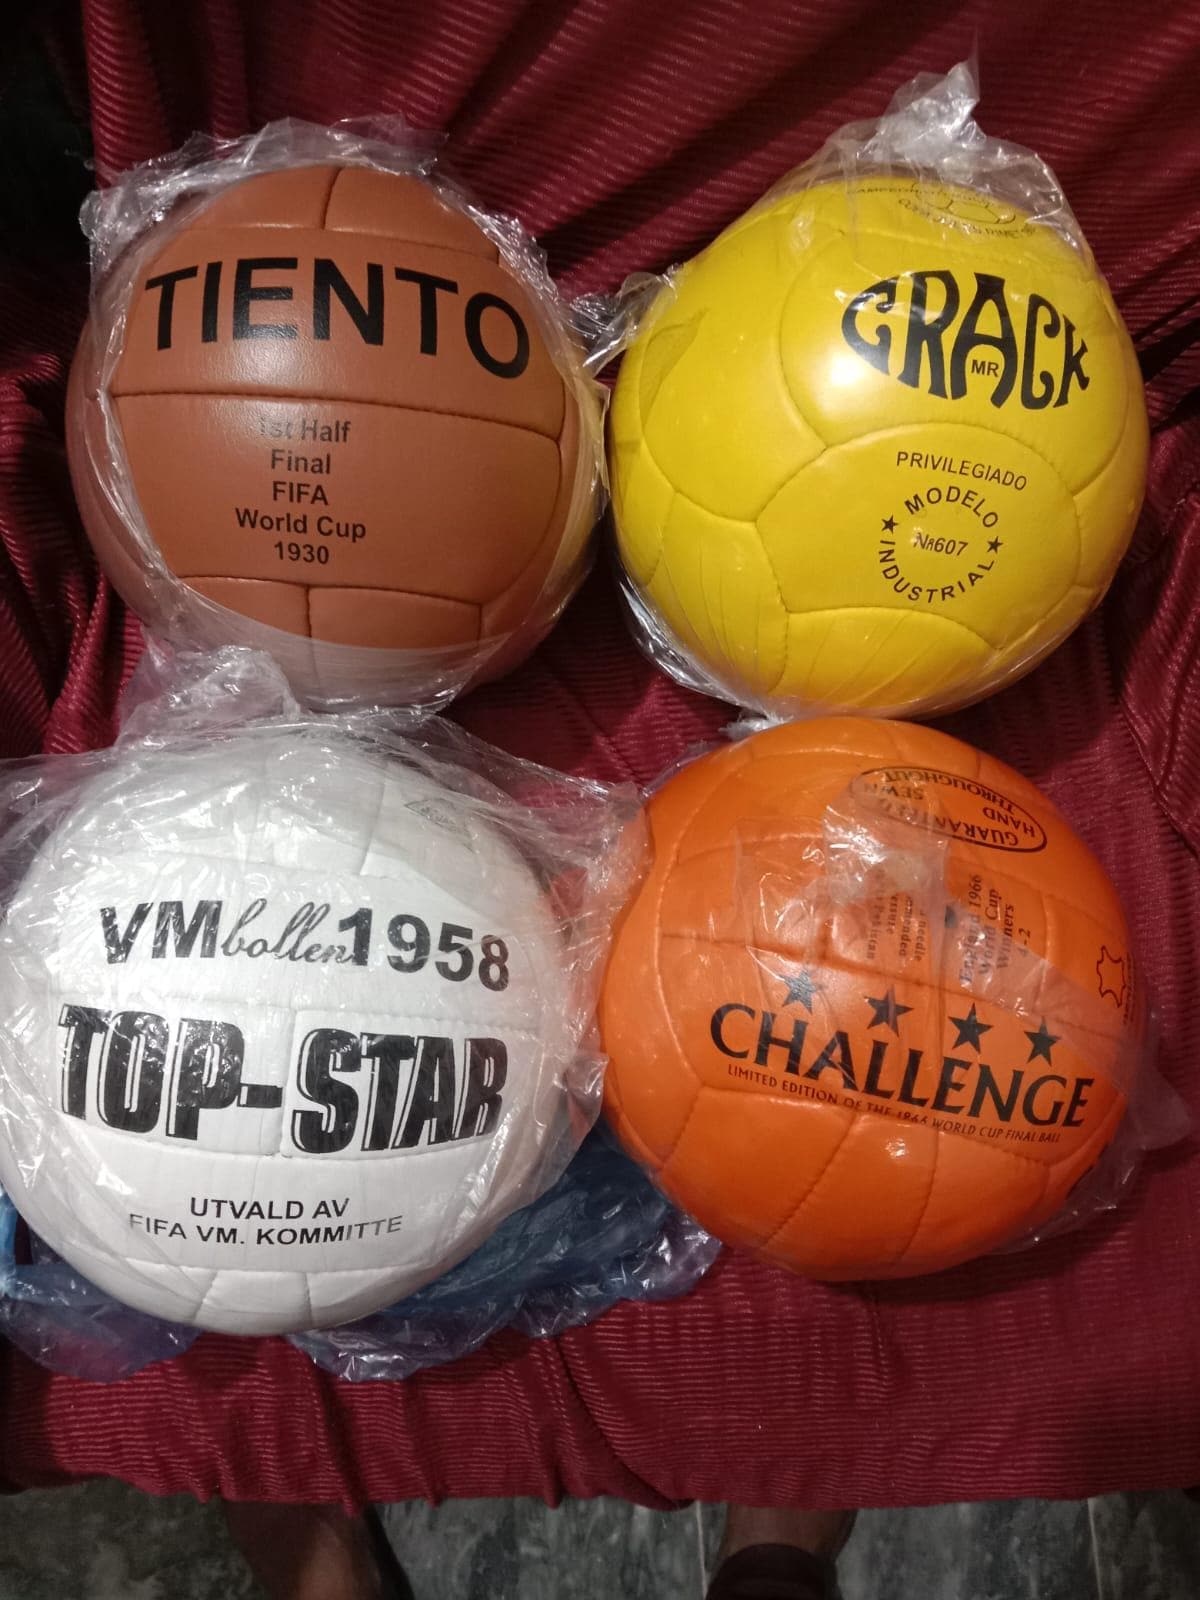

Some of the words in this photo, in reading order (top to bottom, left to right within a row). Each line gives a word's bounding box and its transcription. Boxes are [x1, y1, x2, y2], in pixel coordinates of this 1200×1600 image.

[145, 257, 530, 379] TIENTO
[841, 269, 1090, 410] CRACK
[971, 359, 999, 378] MR
[302, 418, 351, 443] Half
[271, 449, 331, 475] Final
[896, 451, 1028, 492] PRIVILEGIADO
[272, 480, 329, 506] FIFA
[904, 486, 999, 528] MODELO
[235, 507, 307, 534] World
[317, 516, 366, 543] Cup
[274, 541, 330, 565] 1930
[878, 539, 995, 604] INDUSTRIAL
[884, 770, 1014, 815] THROUGHOUT
[983, 806, 1036, 837] HAND
[985, 889, 1003, 921] Cup
[996, 903, 1015, 970] Winners
[58, 1003, 509, 1155] TOP-STAR
[709, 1003, 1095, 1128] CHALLENGE
[727, 1063, 778, 1088] LIMITED
[782, 1080, 838, 1106] EDITION
[843, 1096, 863, 1112] OF
[867, 1101, 892, 1119] THE
[931, 1117, 976, 1136] WORLD
[979, 1125, 1004, 1140] CUP
[1005, 1128, 1036, 1143] FINAL
[1037, 1131, 1061, 1144] BALL
[190, 1196, 305, 1220] UTVALD
[312, 1197, 350, 1219] AV
[129, 1213, 187, 1240] FIFA
[196, 1224, 245, 1245] VM.
[256, 1215, 403, 1245] KOMMITTE
